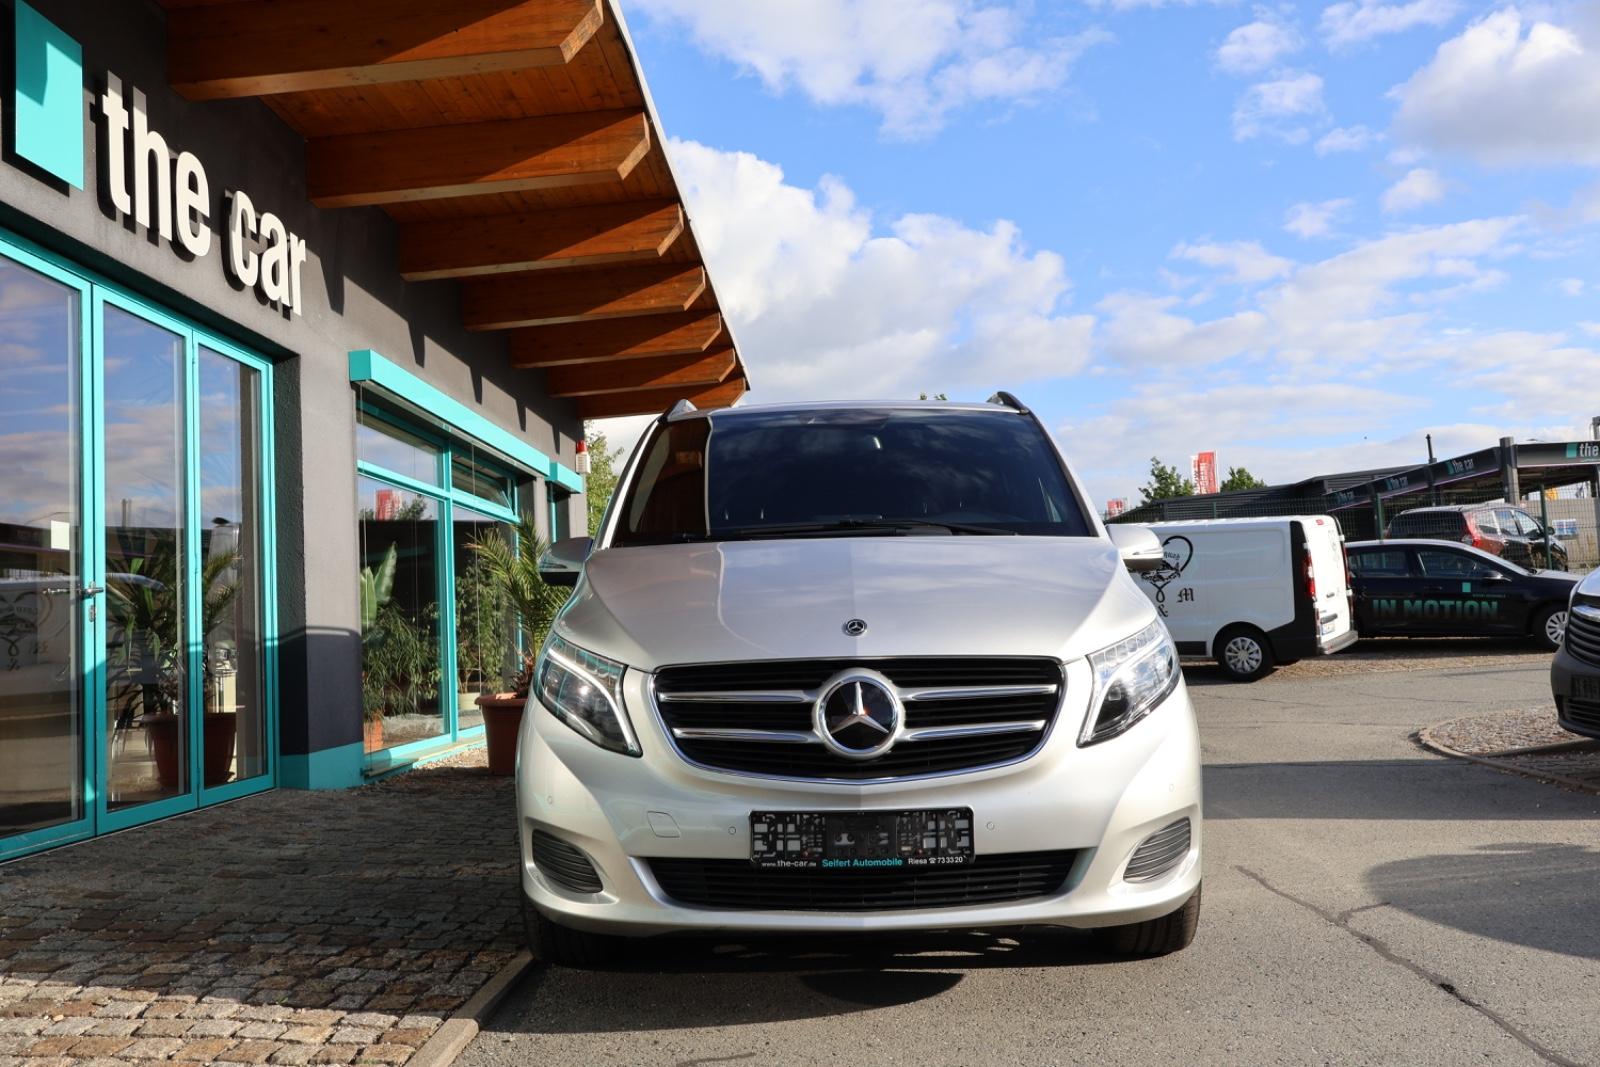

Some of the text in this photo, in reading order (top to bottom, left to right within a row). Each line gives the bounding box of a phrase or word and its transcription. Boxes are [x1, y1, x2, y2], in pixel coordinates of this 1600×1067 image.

[102, 70, 306, 317] the car
[1579, 442, 1599, 458] the
[1373, 599, 1498, 620] IN MOTION
[822, 859, 850, 867] Seifert
[853, 858, 903, 867] Automobile
